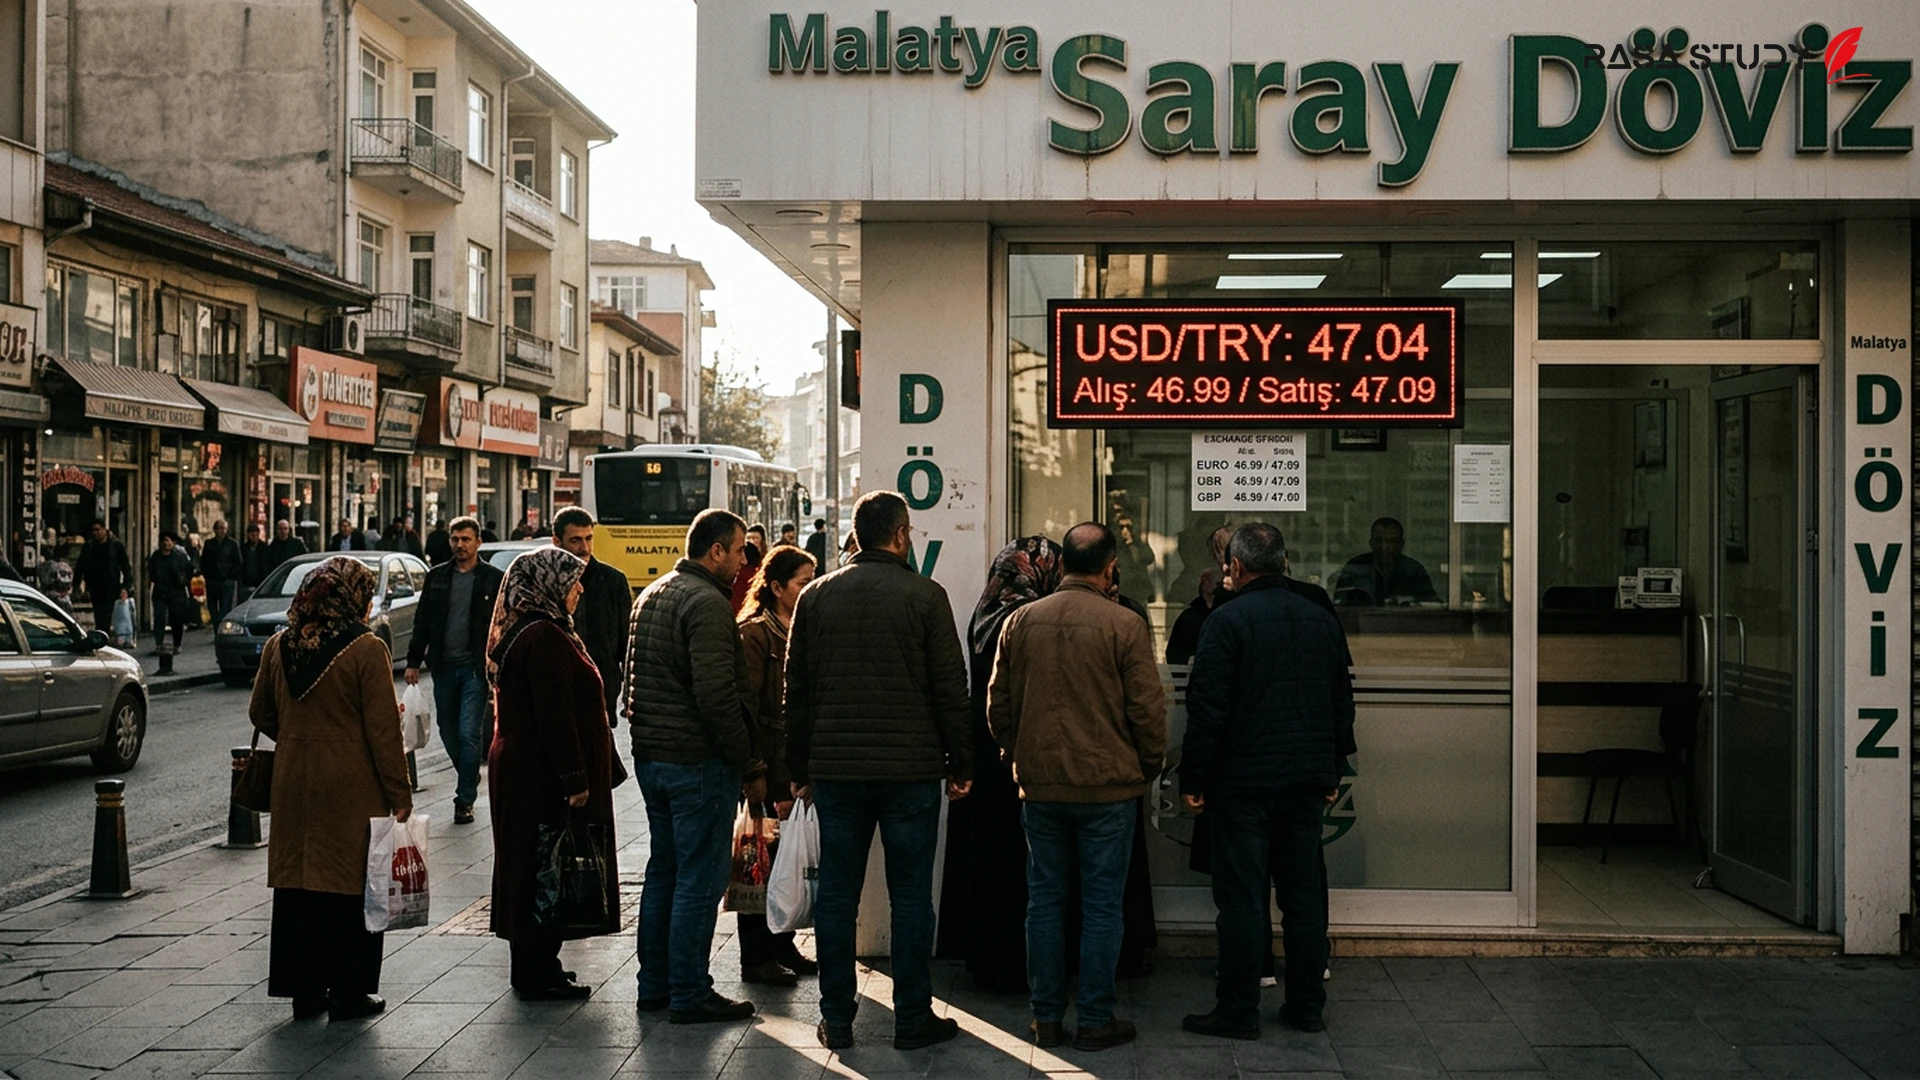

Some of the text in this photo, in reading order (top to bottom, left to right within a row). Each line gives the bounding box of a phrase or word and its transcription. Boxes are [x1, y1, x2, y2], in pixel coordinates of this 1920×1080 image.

[768, 10, 1914, 187] Malatya Saray Döviz
[1076, 323, 1429, 362] USD/TRY: 47.04
[1851, 335, 1906, 352] Malatya
[1073, 377, 1437, 411] Alış: 46.99 / Satış: 47.09
[1197, 460, 1229, 470] EURO
[1234, 460, 1263, 470] 46.99
[1271, 476, 1300, 486] 47.09
[1197, 492, 1221, 502] GBP
[625, 545, 680, 555] MALATYA
